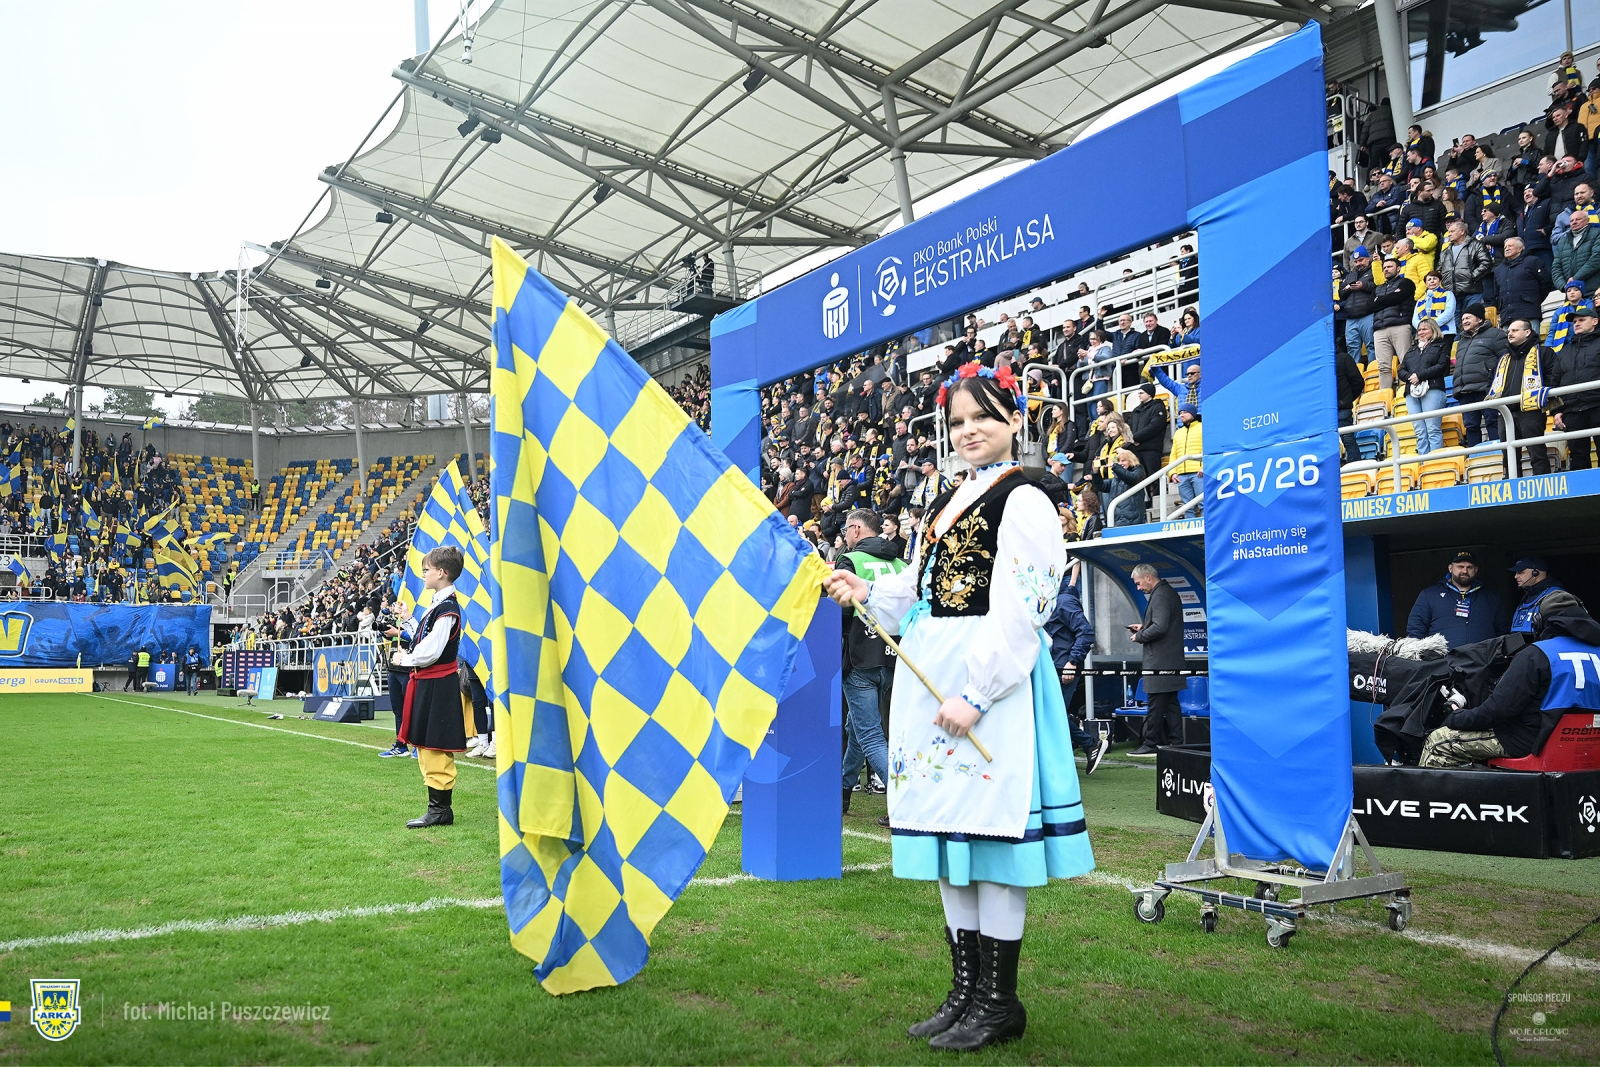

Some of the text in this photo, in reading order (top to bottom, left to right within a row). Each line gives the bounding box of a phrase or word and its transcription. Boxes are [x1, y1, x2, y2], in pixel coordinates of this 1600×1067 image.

[914, 216, 997, 267] PKO Bank Polski
[913, 213, 1055, 297] EKSTRAKLASA
[1242, 412, 1279, 430] SEZON
[1216, 454, 1320, 500] 25/26
[1470, 475, 1568, 505] ARKA GDYNIA
[1396, 492, 1430, 513] SAM
[1232, 525, 1307, 545] Spotkajmy się
[1232, 542, 1309, 561] #NaStadionie
[1429, 801, 1530, 824] PARK
